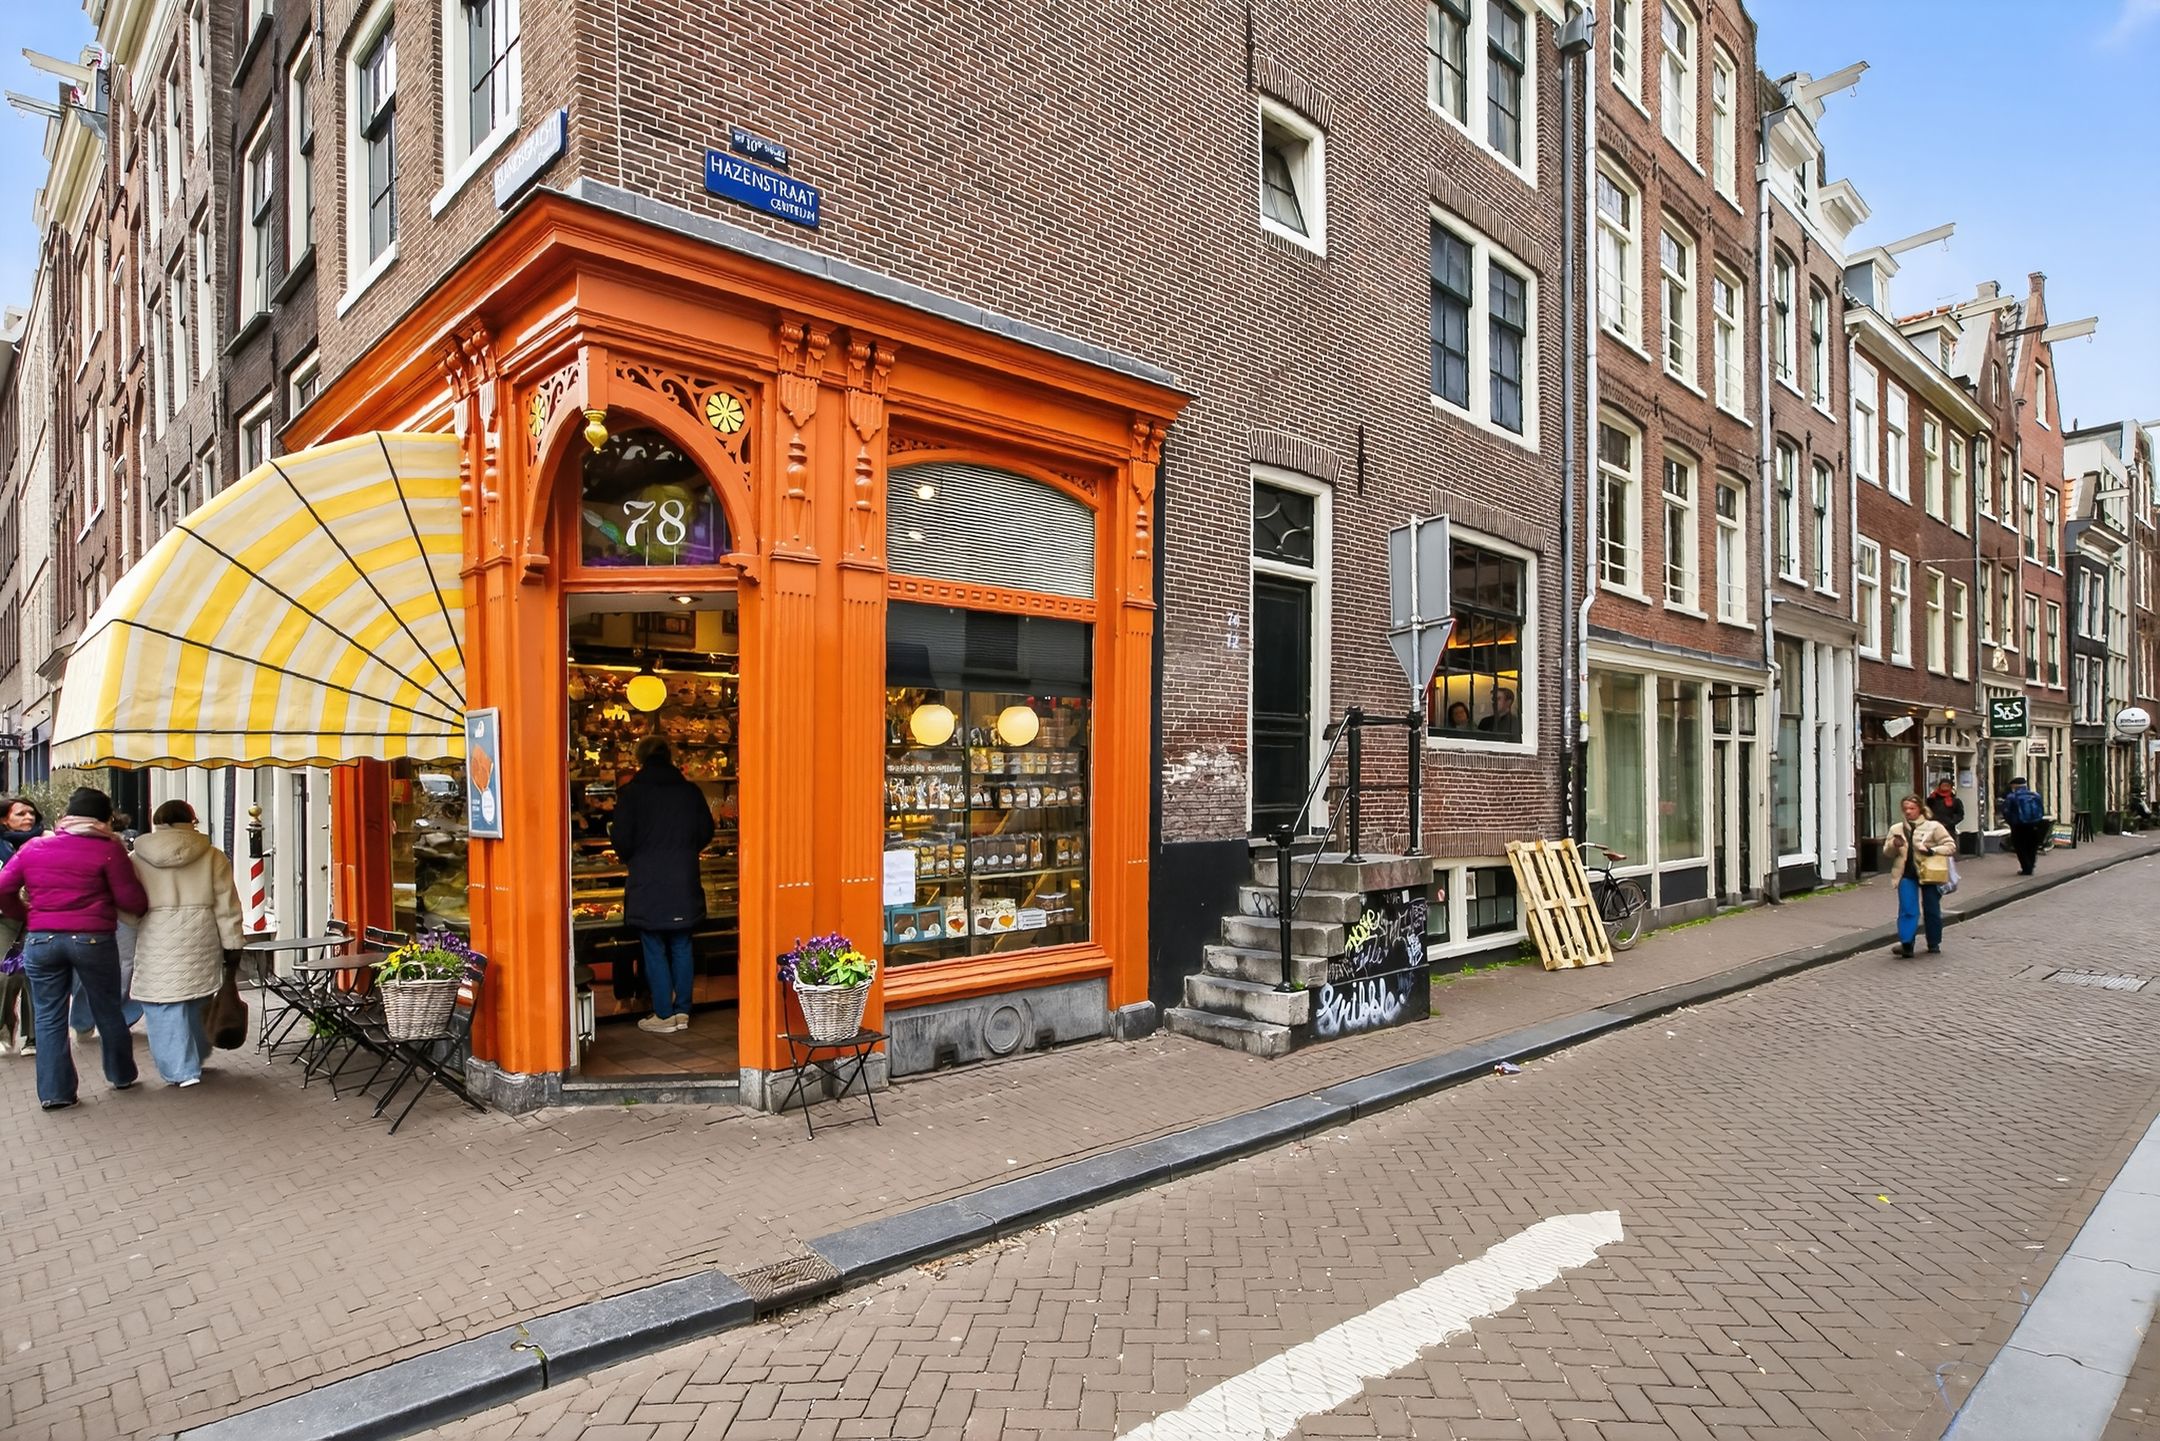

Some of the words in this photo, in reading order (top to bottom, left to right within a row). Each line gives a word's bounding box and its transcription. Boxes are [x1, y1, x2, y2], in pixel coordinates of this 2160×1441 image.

[711, 155, 815, 206] HAZENSTRAAT
[623, 500, 686, 547] 78
[1993, 701, 2023, 720] S&S
